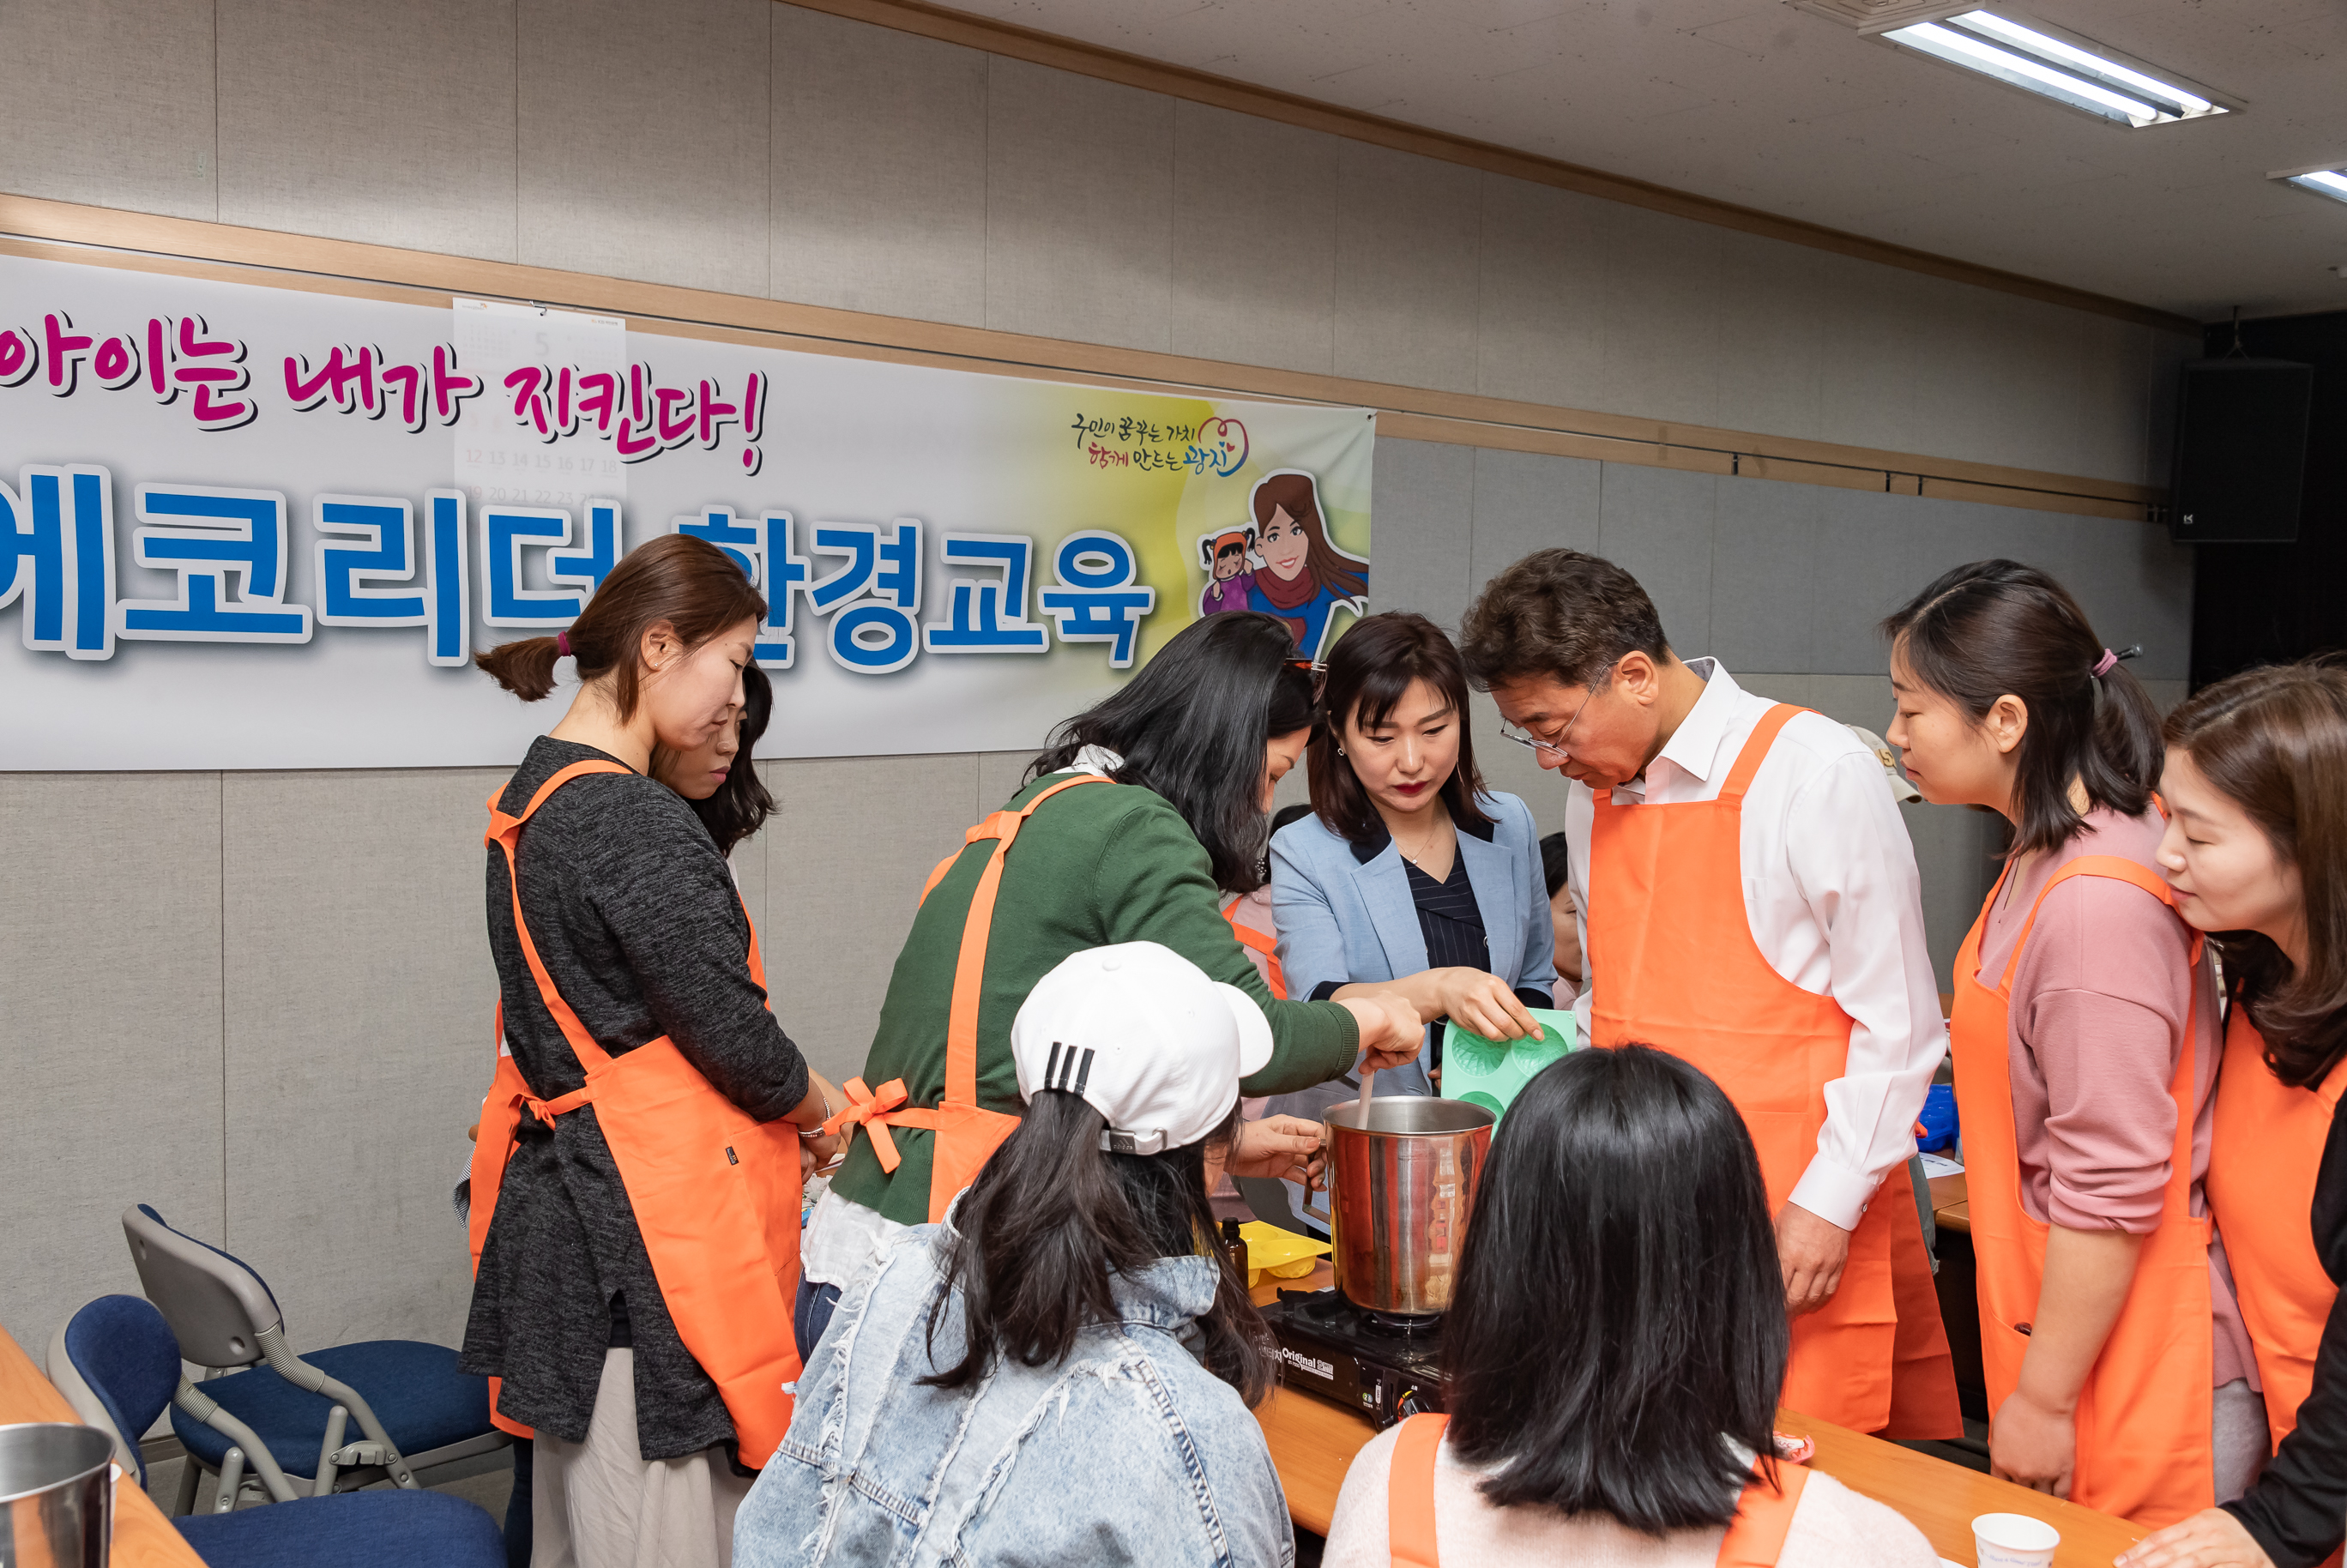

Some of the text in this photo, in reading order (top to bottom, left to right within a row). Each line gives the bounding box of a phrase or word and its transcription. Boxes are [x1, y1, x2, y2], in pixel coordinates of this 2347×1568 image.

[535, 331, 550, 357] 5
[0, 312, 769, 477] 아이는 내가 지킨다!
[1071, 413, 1195, 449] 구민이 꿈꾸는 가치
[467, 449, 618, 473] 12 13 14 15 16 17 18
[1088, 442, 1129, 469] 함께
[1133, 448, 1183, 472] 만드는
[468, 485, 482, 500] 19
[489, 487, 506, 501] 20
[512, 489, 528, 503] 21
[535, 490, 552, 504] 22
[558, 492, 573, 505] 23
[0, 464, 622, 666] 에코리더
[1282, 1347, 1316, 1371] Original
